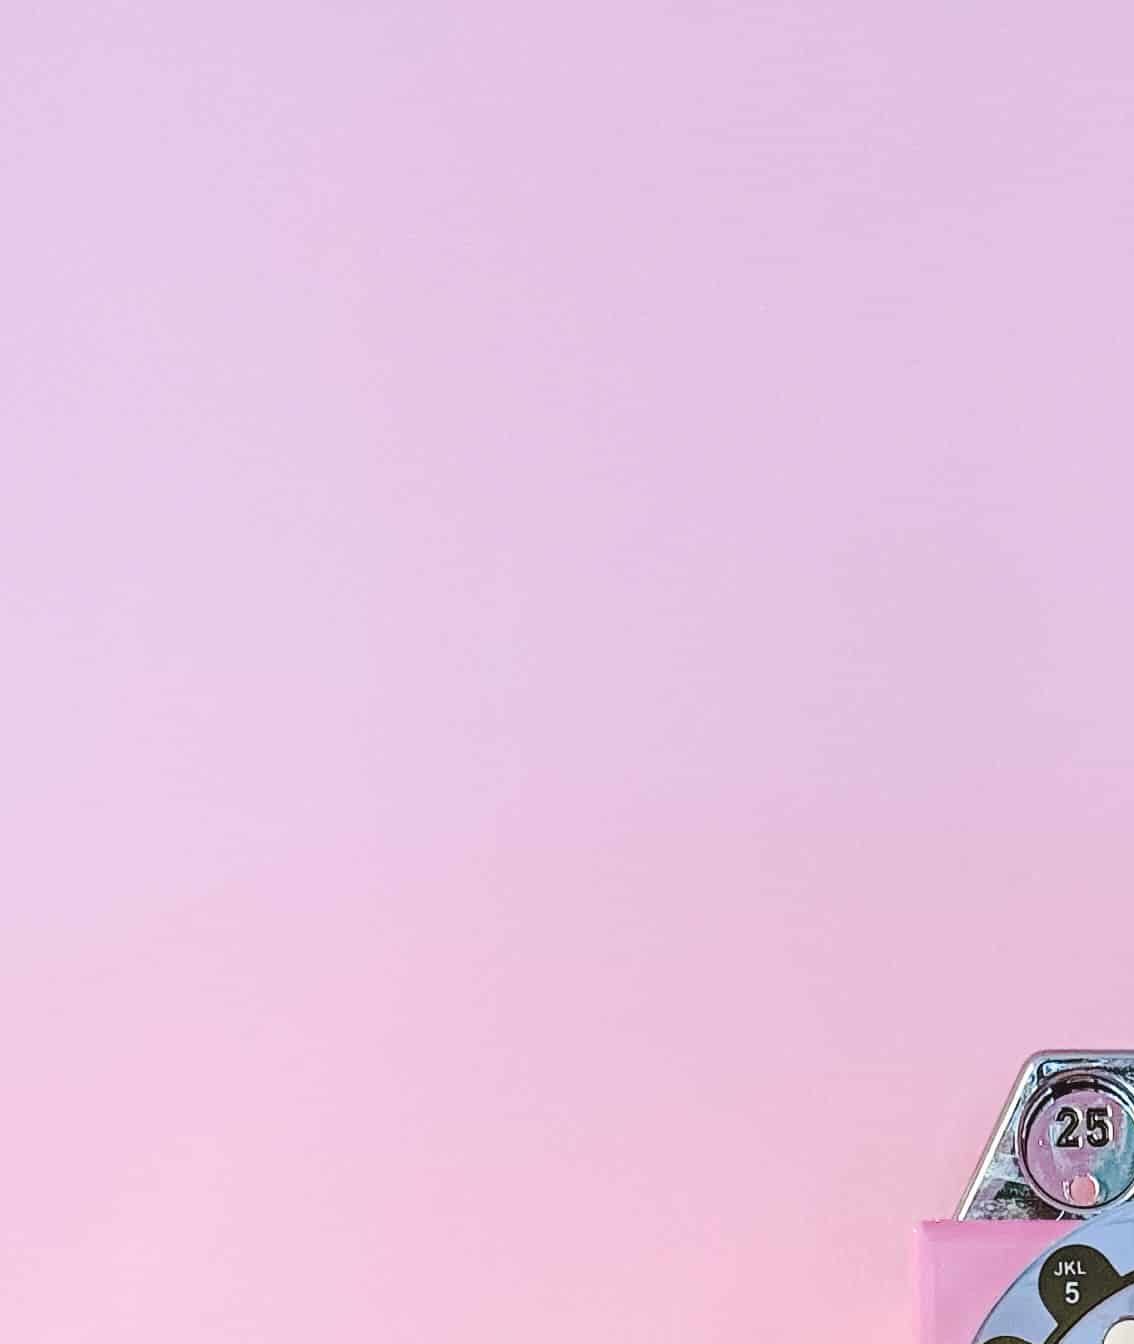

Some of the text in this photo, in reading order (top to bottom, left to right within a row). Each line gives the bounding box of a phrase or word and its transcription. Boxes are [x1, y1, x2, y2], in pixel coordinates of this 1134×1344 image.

[1054, 1106, 1112, 1148] 25
[1053, 1260, 1087, 1276] JKL
[1065, 1281, 1080, 1304] 5
